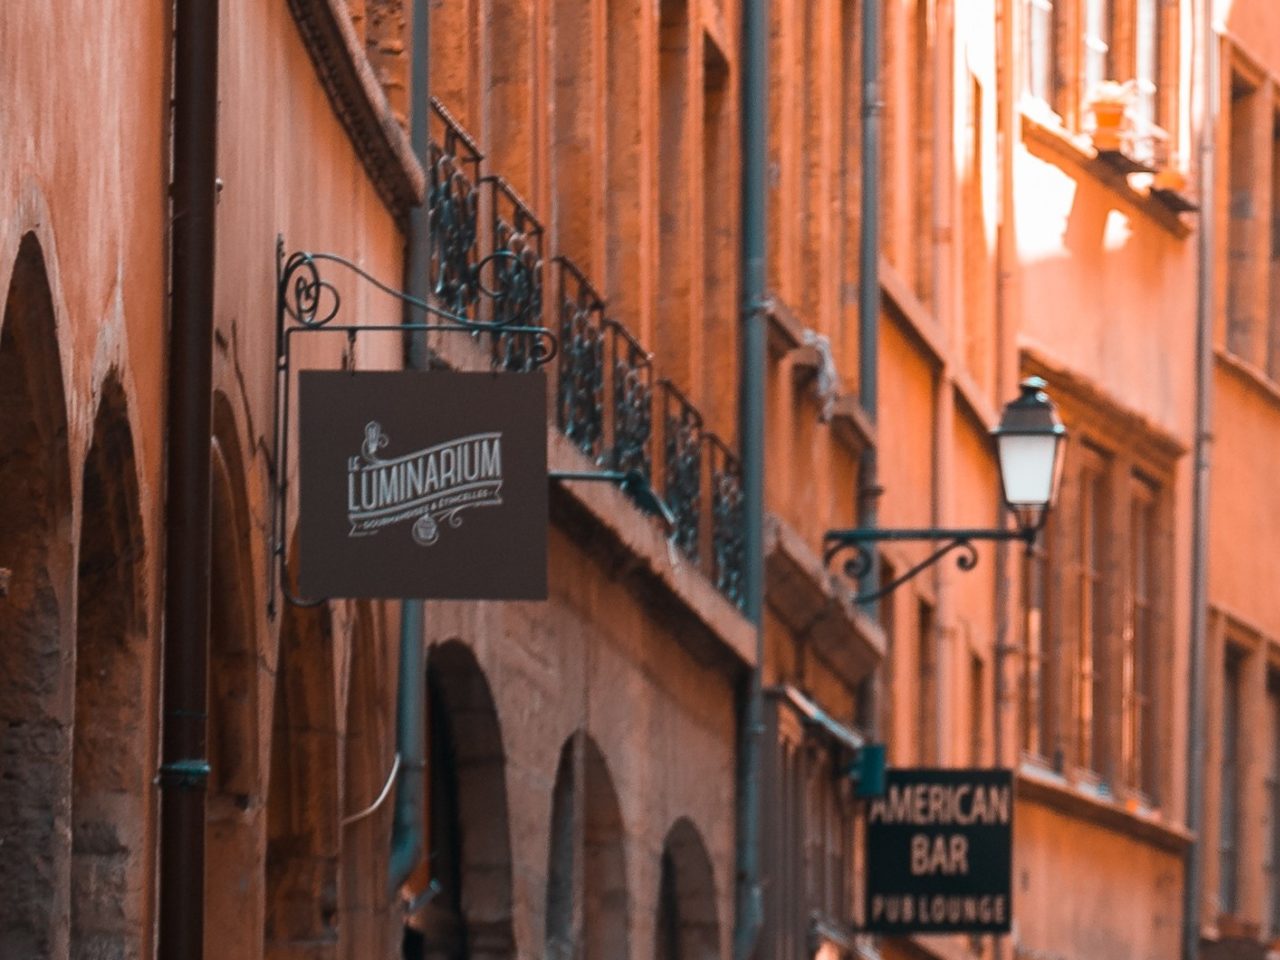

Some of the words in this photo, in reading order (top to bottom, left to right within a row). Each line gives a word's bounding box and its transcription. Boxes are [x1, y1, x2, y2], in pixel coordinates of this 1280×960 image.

[348, 438, 501, 512] LUMINARIUM
[869, 783, 1009, 825] AMERICAN
[910, 833, 969, 876] BAR
[871, 894, 914, 924] PUB
[918, 894, 1005, 924] LOUNGE
